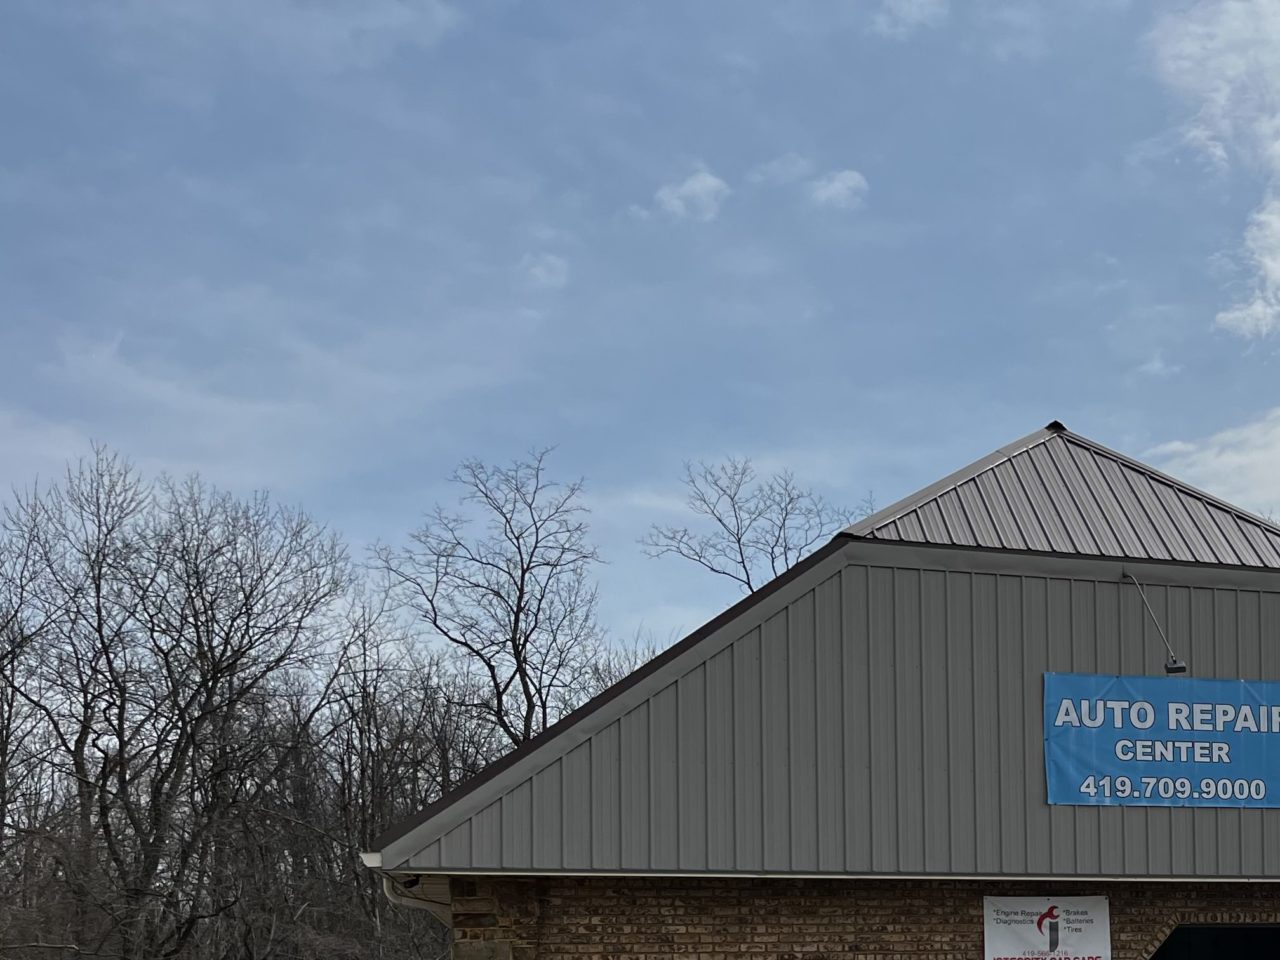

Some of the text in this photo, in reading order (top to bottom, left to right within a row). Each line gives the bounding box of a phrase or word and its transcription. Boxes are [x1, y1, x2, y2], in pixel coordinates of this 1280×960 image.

[1054, 698, 1155, 729] AUTO
[1115, 740, 1230, 763] CENTER
[1080, 776, 1266, 800] 419.709.9000
